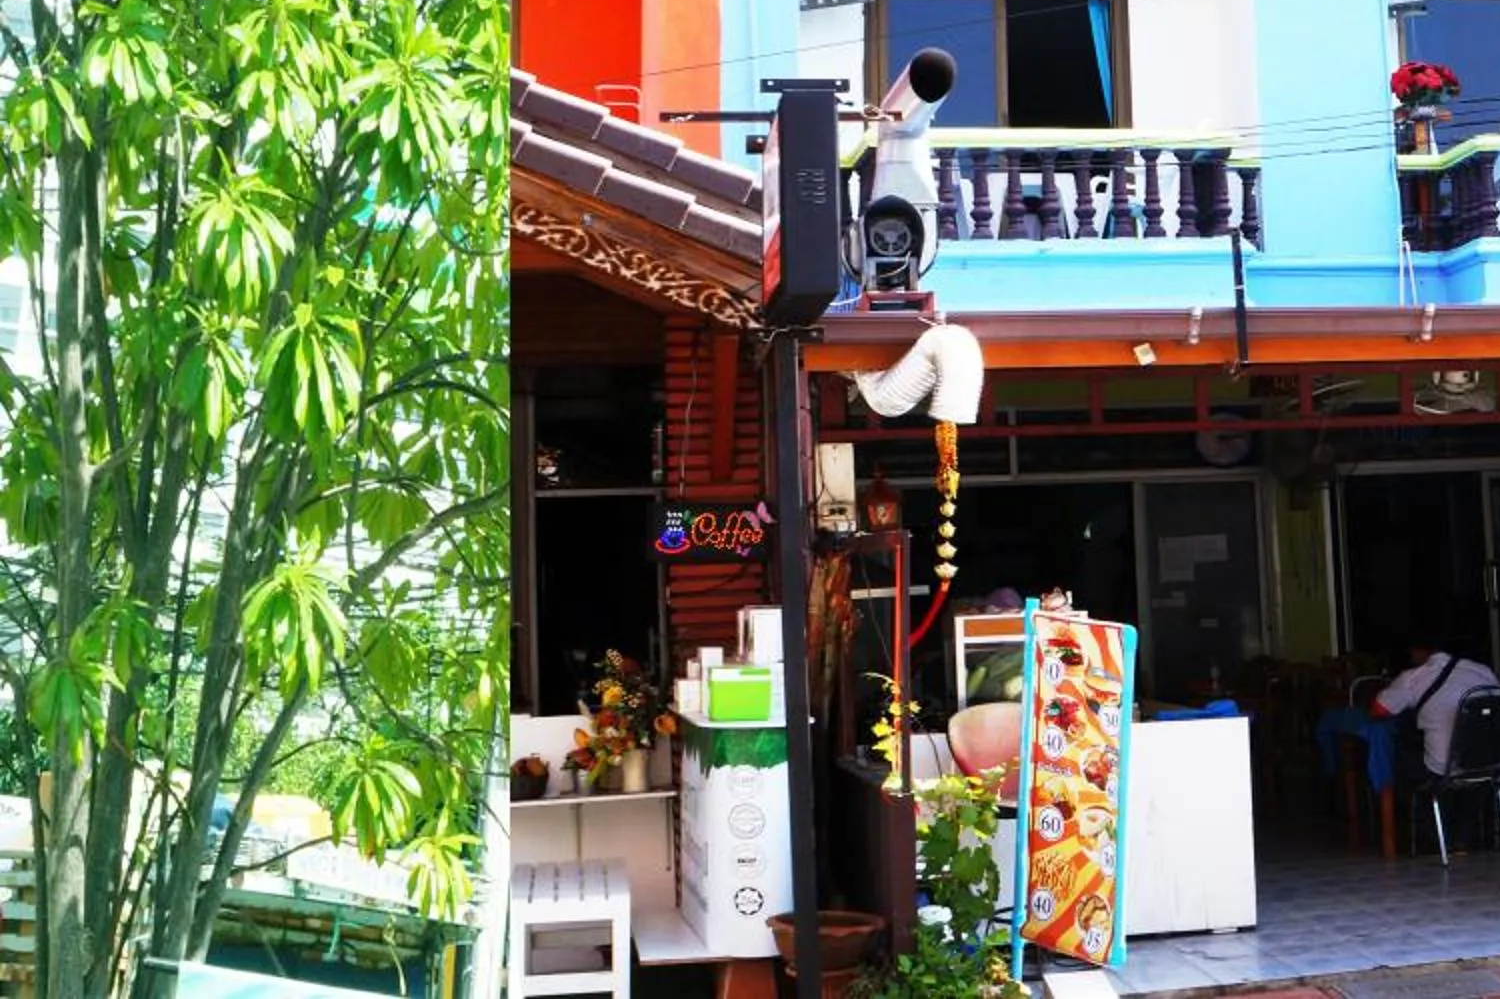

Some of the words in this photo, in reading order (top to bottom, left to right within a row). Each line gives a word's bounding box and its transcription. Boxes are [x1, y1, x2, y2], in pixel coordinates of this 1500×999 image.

[691, 511, 764, 550] Coffee
[1040, 815, 1061, 835] 60
[1033, 896, 1053, 915] 40
